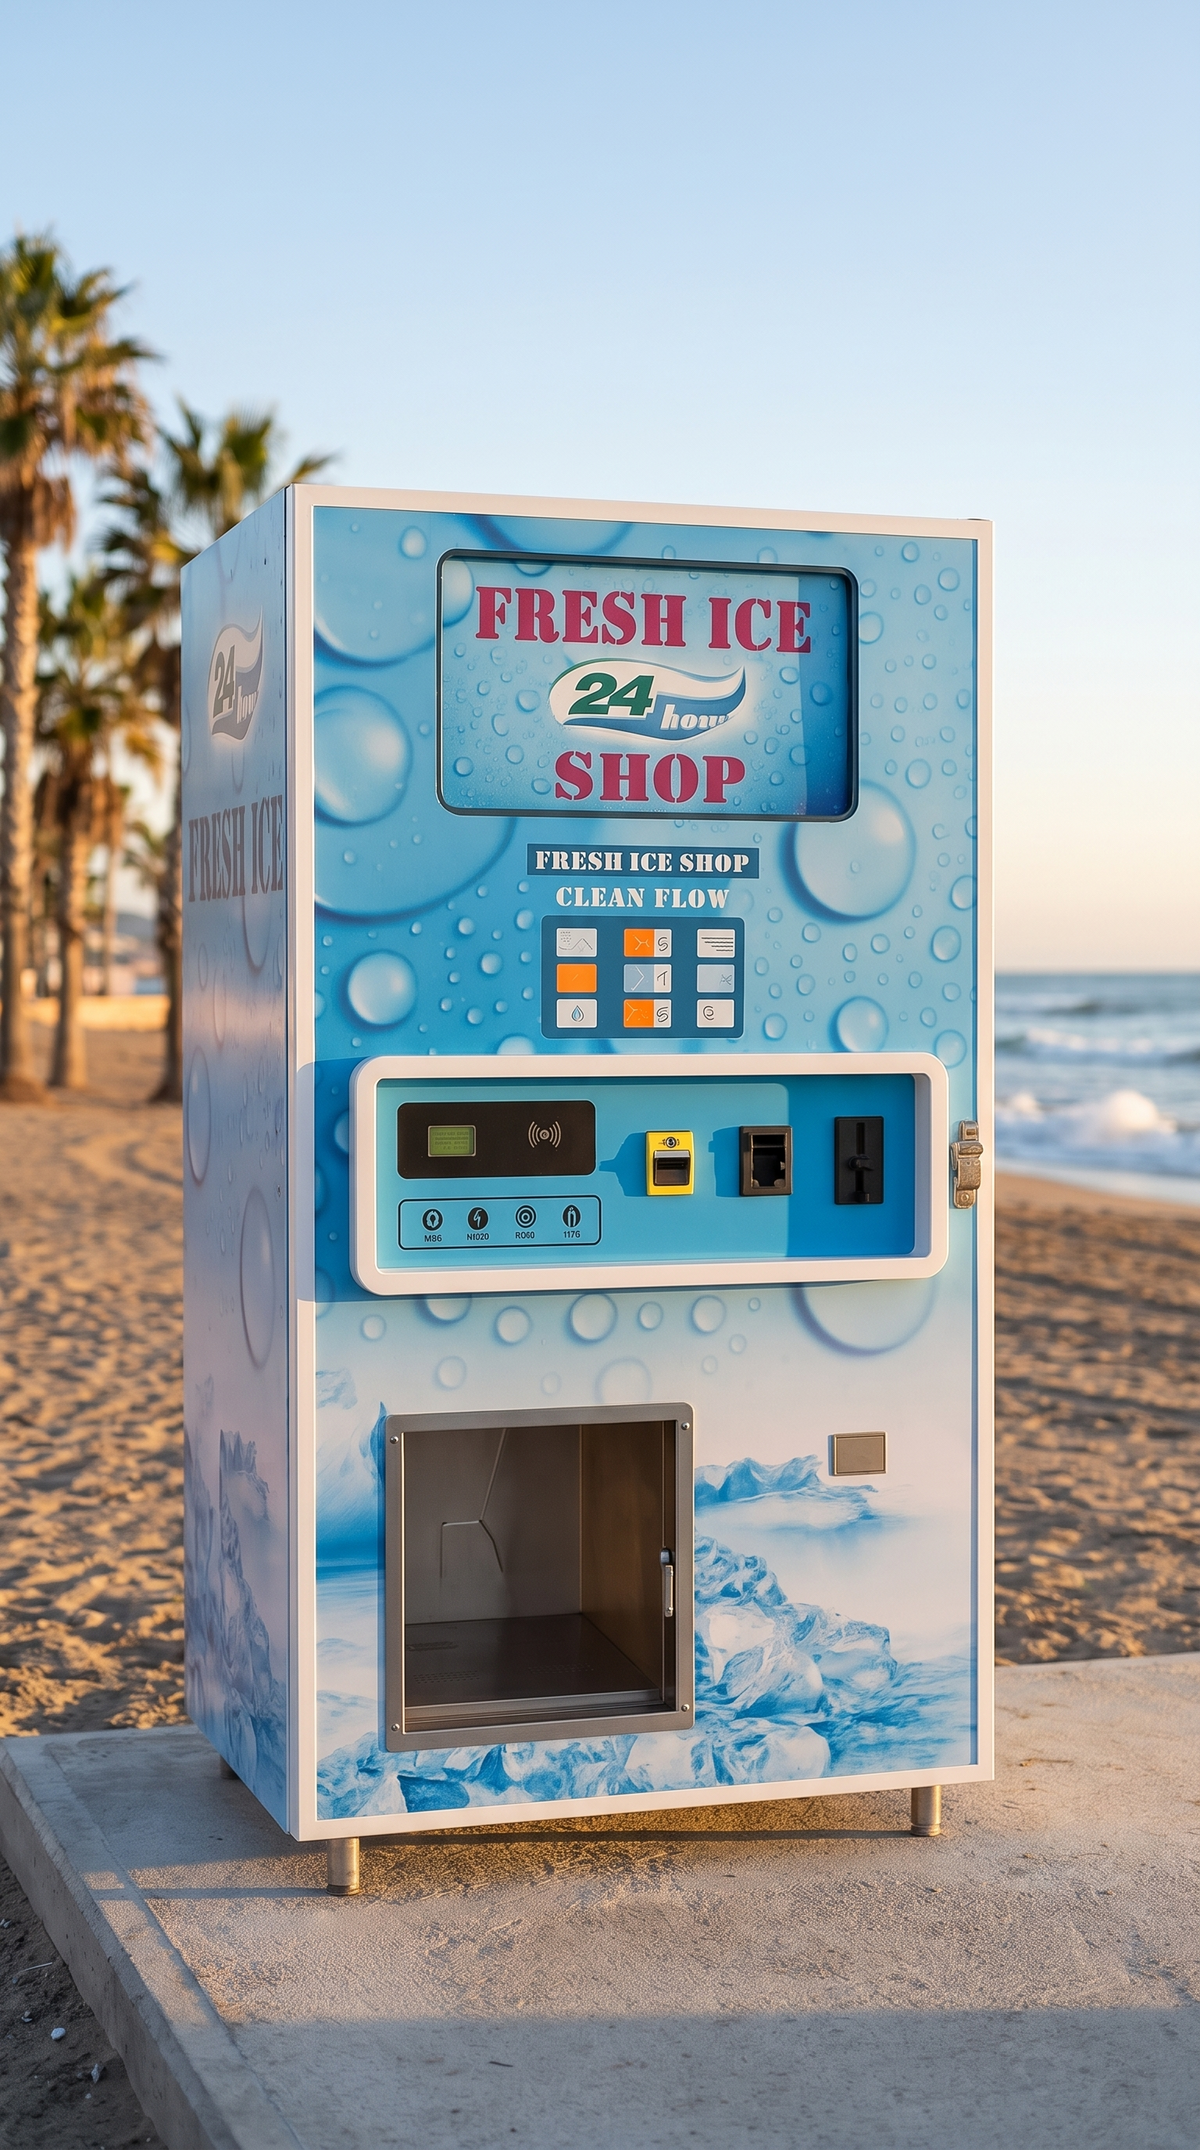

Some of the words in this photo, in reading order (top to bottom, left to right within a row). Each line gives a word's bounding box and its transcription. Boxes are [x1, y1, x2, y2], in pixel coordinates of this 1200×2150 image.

[475, 585, 687, 648] FRESH
[708, 597, 811, 654] ICE
[212, 643, 235, 719] 24
[568, 673, 655, 717] 24
[554, 751, 746, 804] SHOP
[188, 805, 246, 902] FRESH
[250, 794, 284, 895] ICE
[535, 850, 623, 871] FRESH
[629, 852, 673, 872] ICE
[679, 853, 750, 873] SHOP
[555, 886, 646, 908] CLEAN
[654, 888, 730, 909] FLOW
